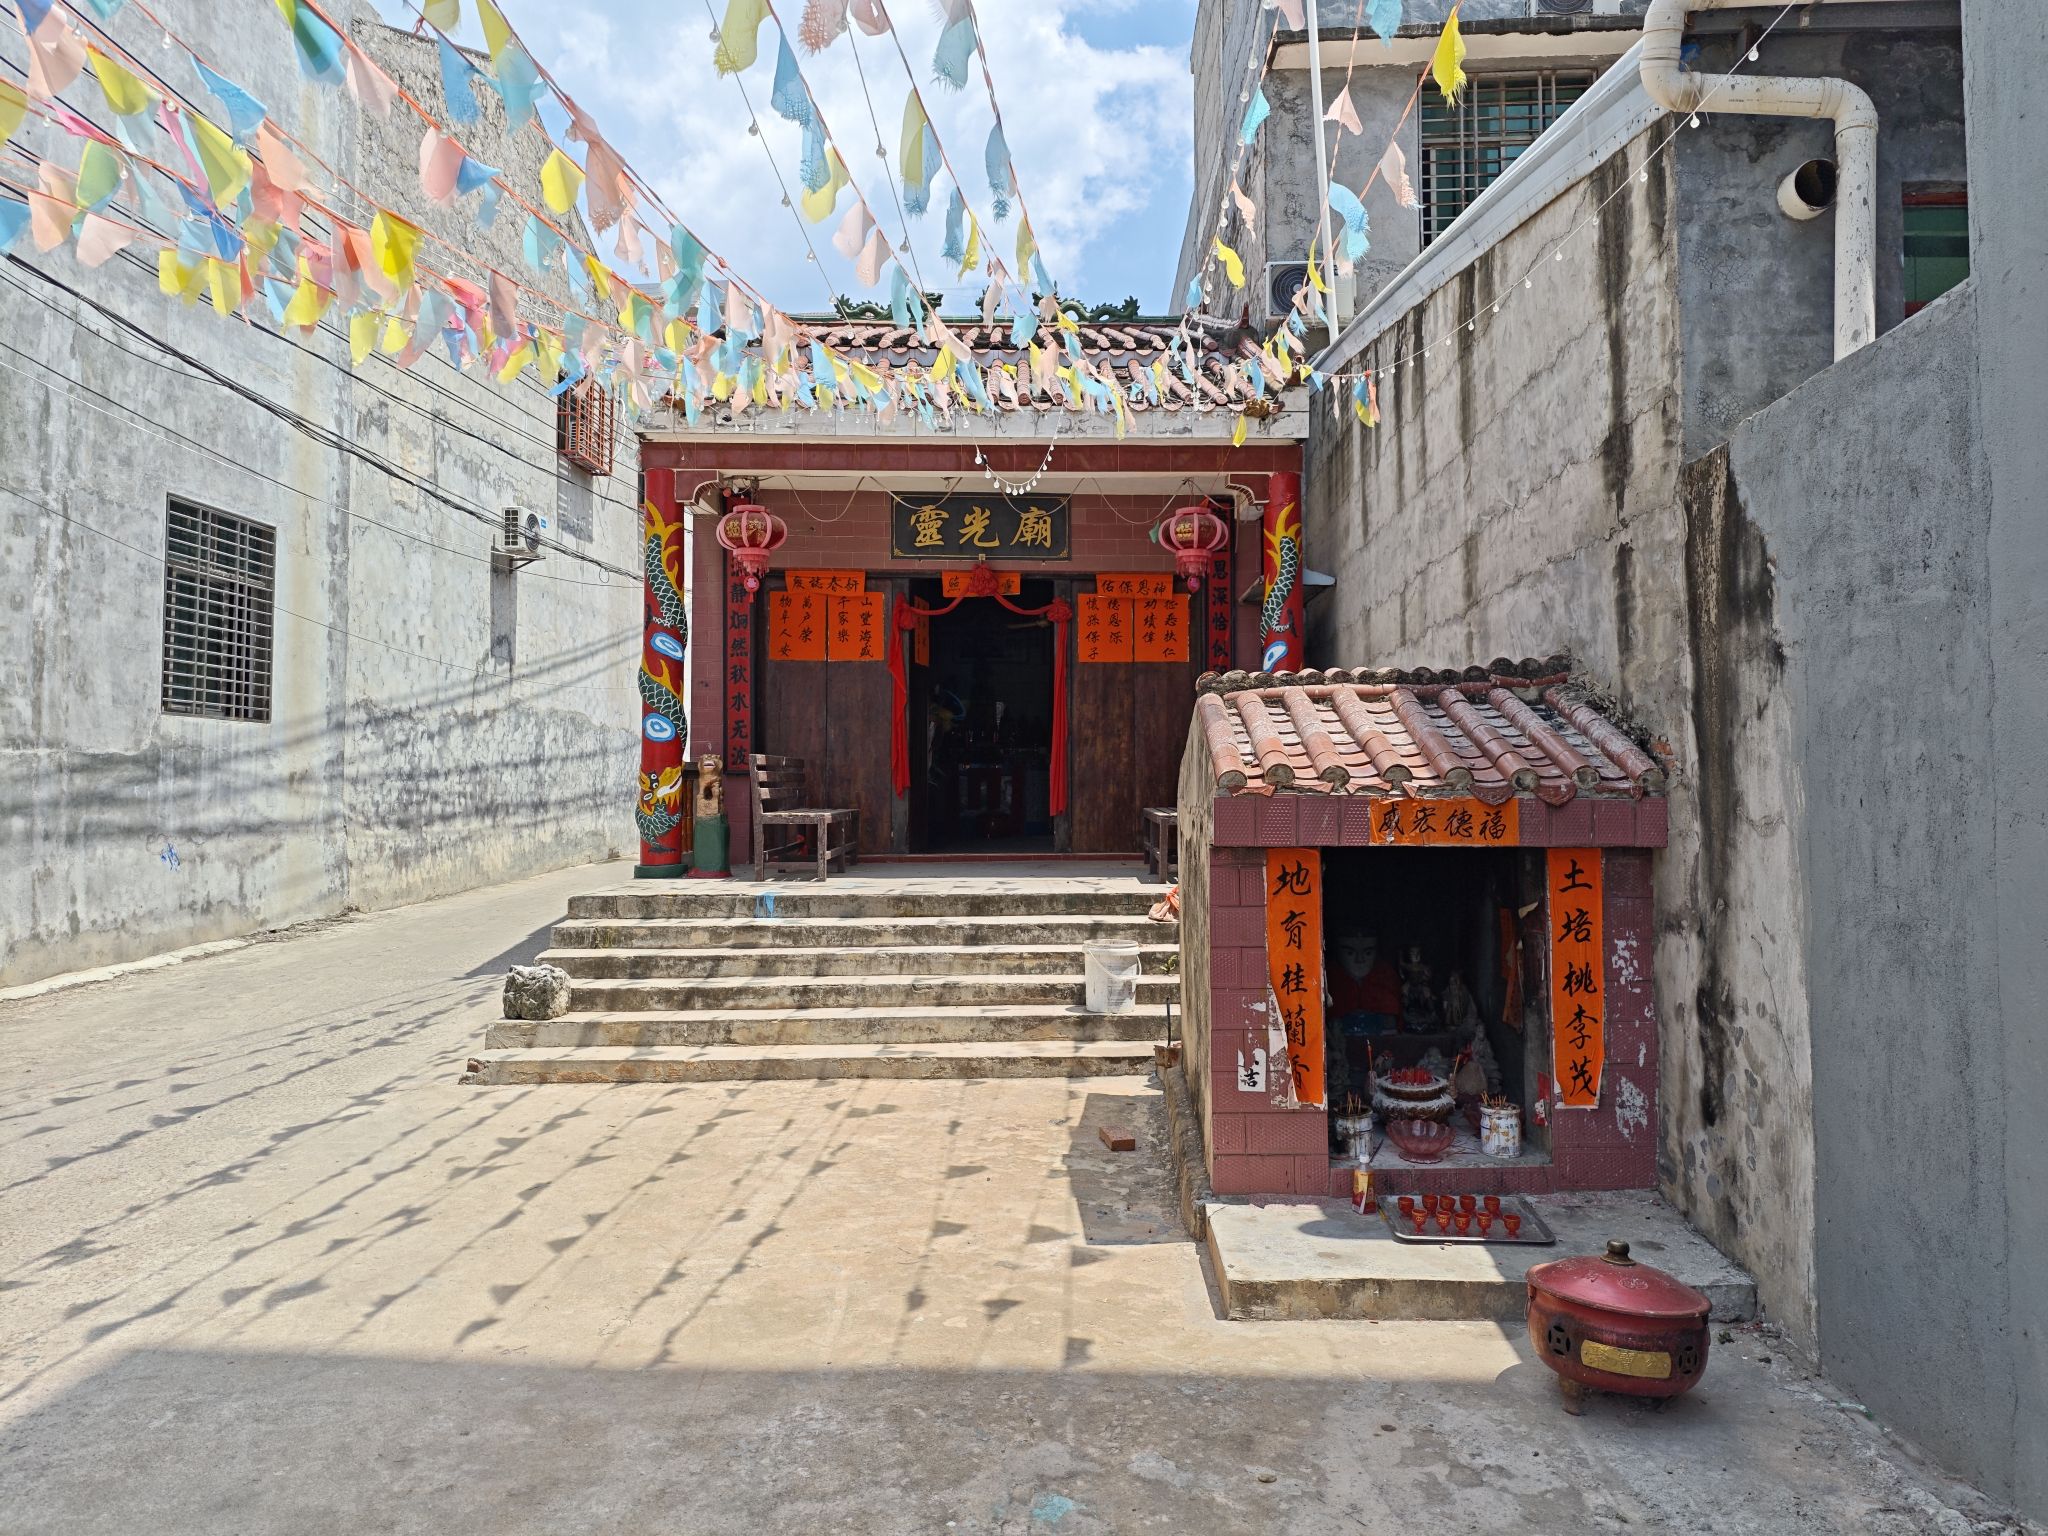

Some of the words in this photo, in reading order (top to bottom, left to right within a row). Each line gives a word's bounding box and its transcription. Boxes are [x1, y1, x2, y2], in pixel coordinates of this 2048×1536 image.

[910, 504, 1053, 549] 靈光廟
[1558, 859, 1598, 1098] 土培桃李茂
